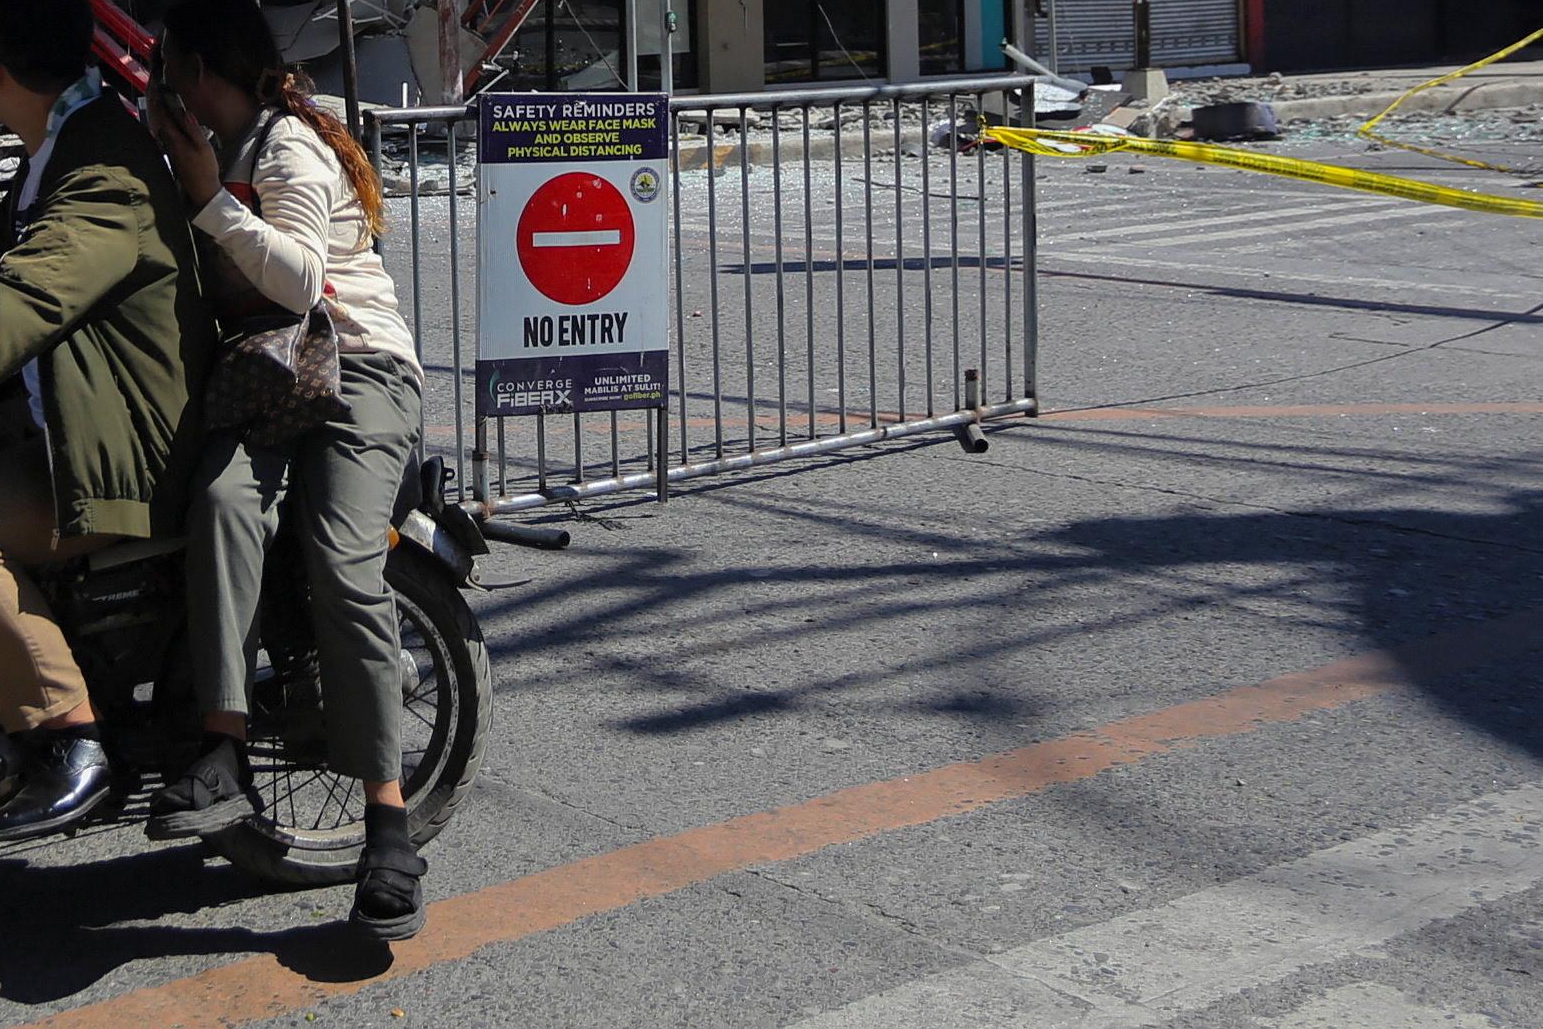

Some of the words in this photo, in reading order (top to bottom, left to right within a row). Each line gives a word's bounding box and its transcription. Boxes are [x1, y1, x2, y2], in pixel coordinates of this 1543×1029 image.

[493, 105, 557, 119] SAFETY
[562, 103, 656, 118] REMINDERS
[492, 121, 546, 132] ALWAYS
[549, 120, 587, 131] WEAR
[589, 119, 620, 130] FACE
[622, 118, 656, 129] MASK
[534, 134, 561, 144] AND
[564, 132, 619, 143] OBSERVE
[508, 146, 568, 158] PHYSICAL
[570, 144, 642, 156] DISTANCING
[523, 316, 553, 348] NO
[558, 312, 628, 346] ENTRY
[497, 379, 573, 392] CONVERGE
[594, 374, 651, 385] UNLIMITED
[584, 386, 619, 394] MABILIS
[621, 384, 633, 392] AT
[634, 383, 661, 391] SULIT!
